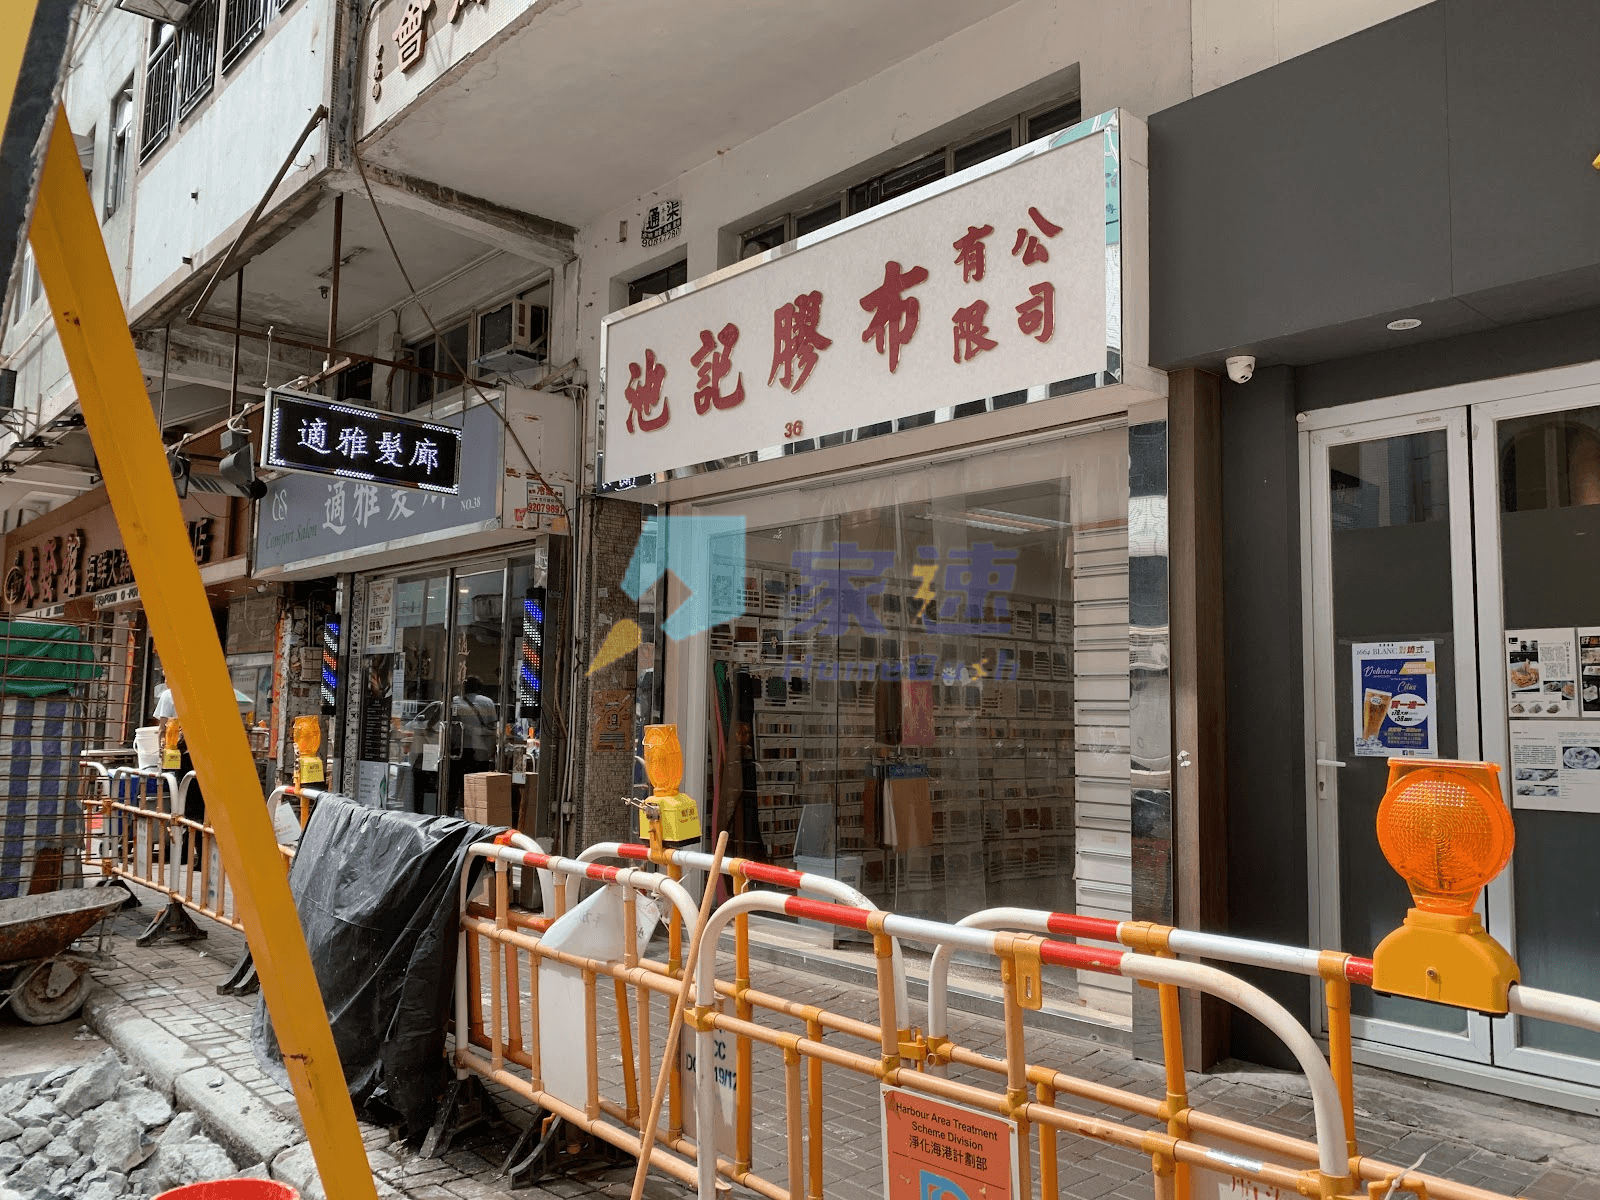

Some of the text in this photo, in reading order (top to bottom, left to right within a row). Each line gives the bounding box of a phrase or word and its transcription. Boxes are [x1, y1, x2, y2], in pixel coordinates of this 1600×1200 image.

[784, 420, 803, 438] 36
[297, 417, 439, 475] 適雅髮廊
[460, 497, 481, 511] NO.38
[1373, 648, 1398, 656] BLANC
[1363, 665, 1398, 677] Delicious
[896, 1102, 998, 1141] Harbour Area Treatment
[911, 1121, 984, 1152] Scheme Division
[909, 1134, 988, 1172] 淨化海港計劃部
